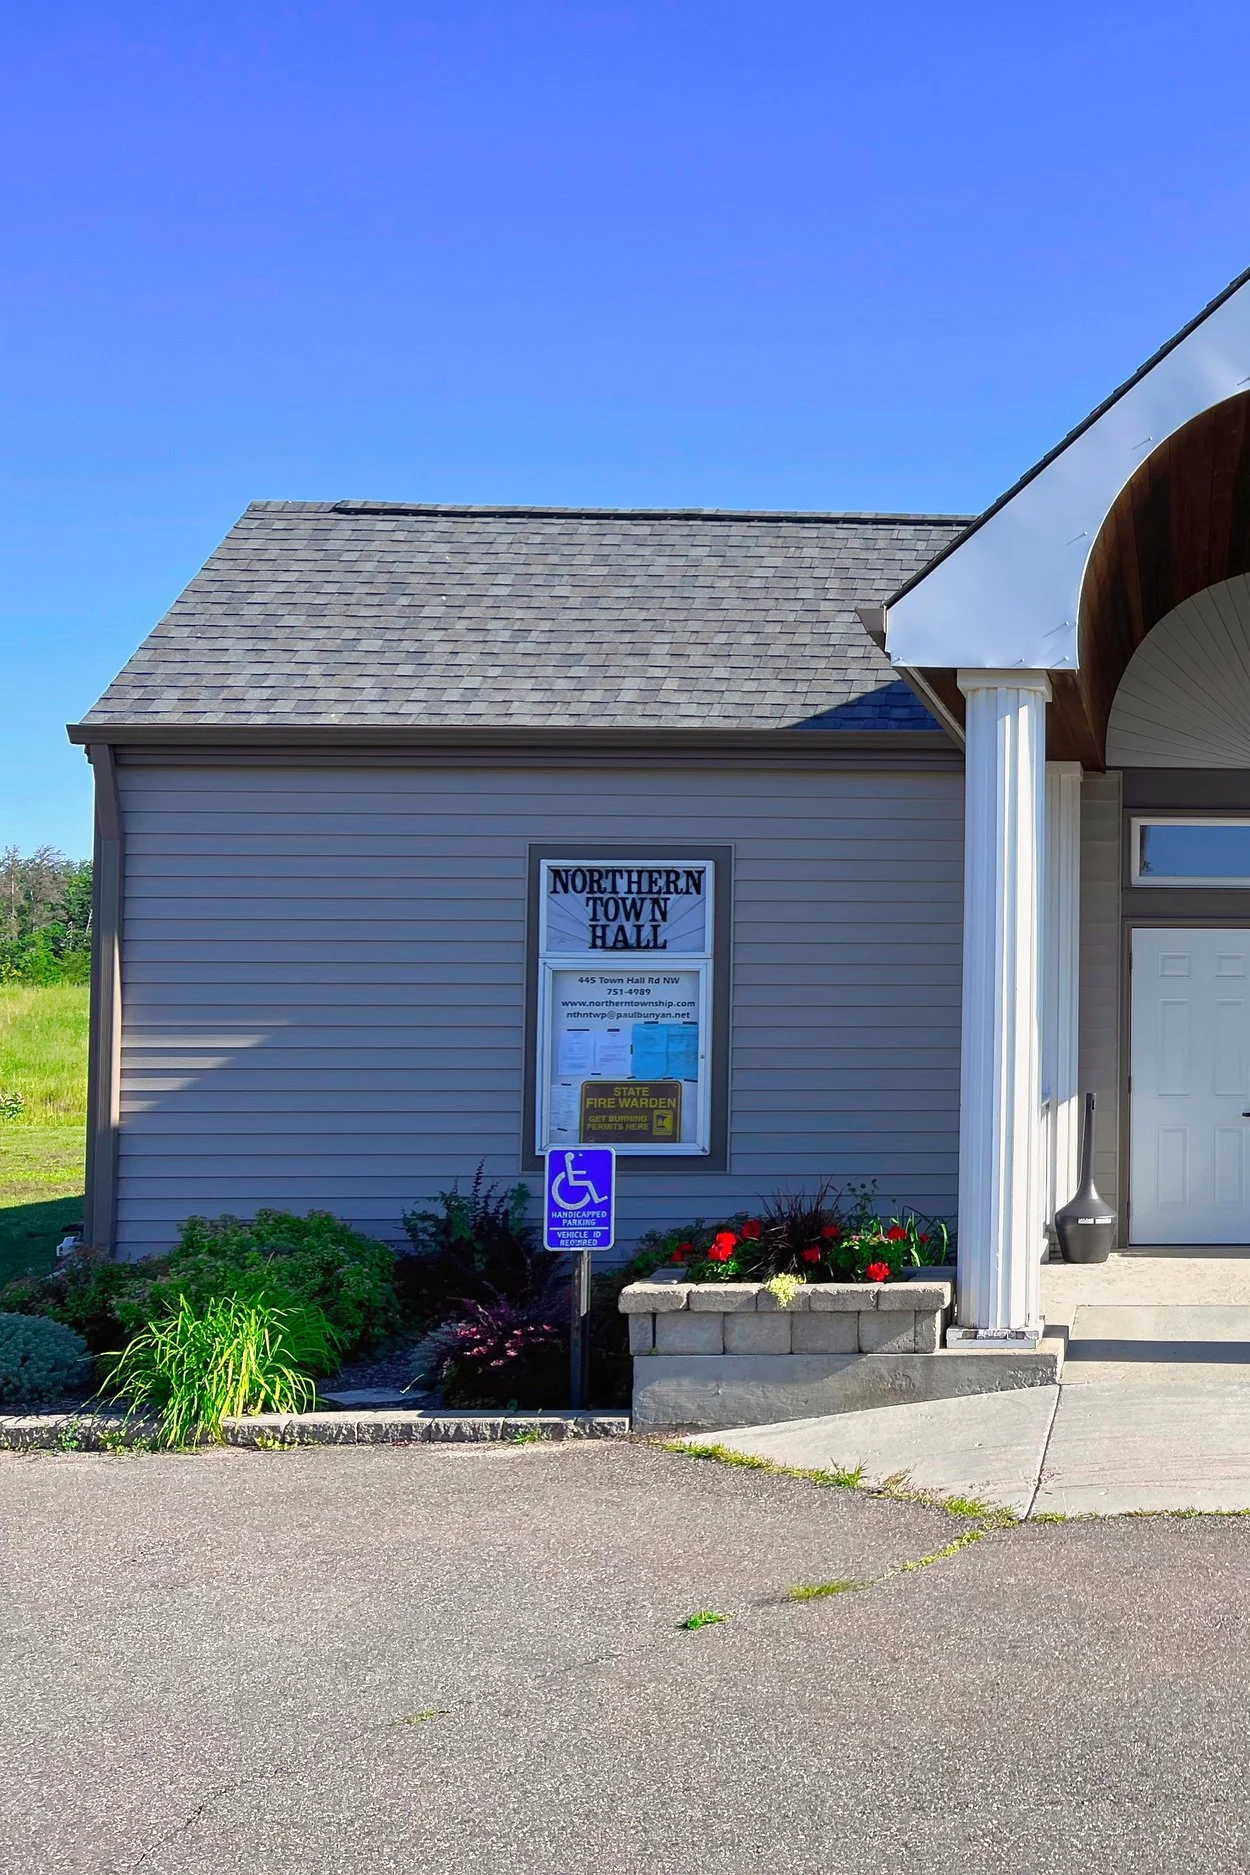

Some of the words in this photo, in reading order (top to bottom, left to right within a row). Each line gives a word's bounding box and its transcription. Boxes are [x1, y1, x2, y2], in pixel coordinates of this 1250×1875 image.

[550, 868, 704, 895] NORTHERN
[586, 897, 670, 922] TOWN
[588, 924, 667, 949] HALL
[578, 976, 596, 984] 445
[599, 976, 624, 984] Town
[626, 976, 645, 984] Hall
[606, 988, 651, 996] 751-4989
[561, 1000, 696, 1008] www.northerntownship.com
[566, 1011, 690, 1020] nthntwp@paulbunyan.net
[613, 1087, 649, 1097] STATE
[585, 1098, 616, 1108] FIRE
[619, 1098, 676, 1108] WARDEN
[588, 1115, 607, 1123] GET
[608, 1115, 648, 1123] BURNING
[586, 1123, 624, 1131] PERMITS
[557, 1231, 589, 1239] VEHICLE
